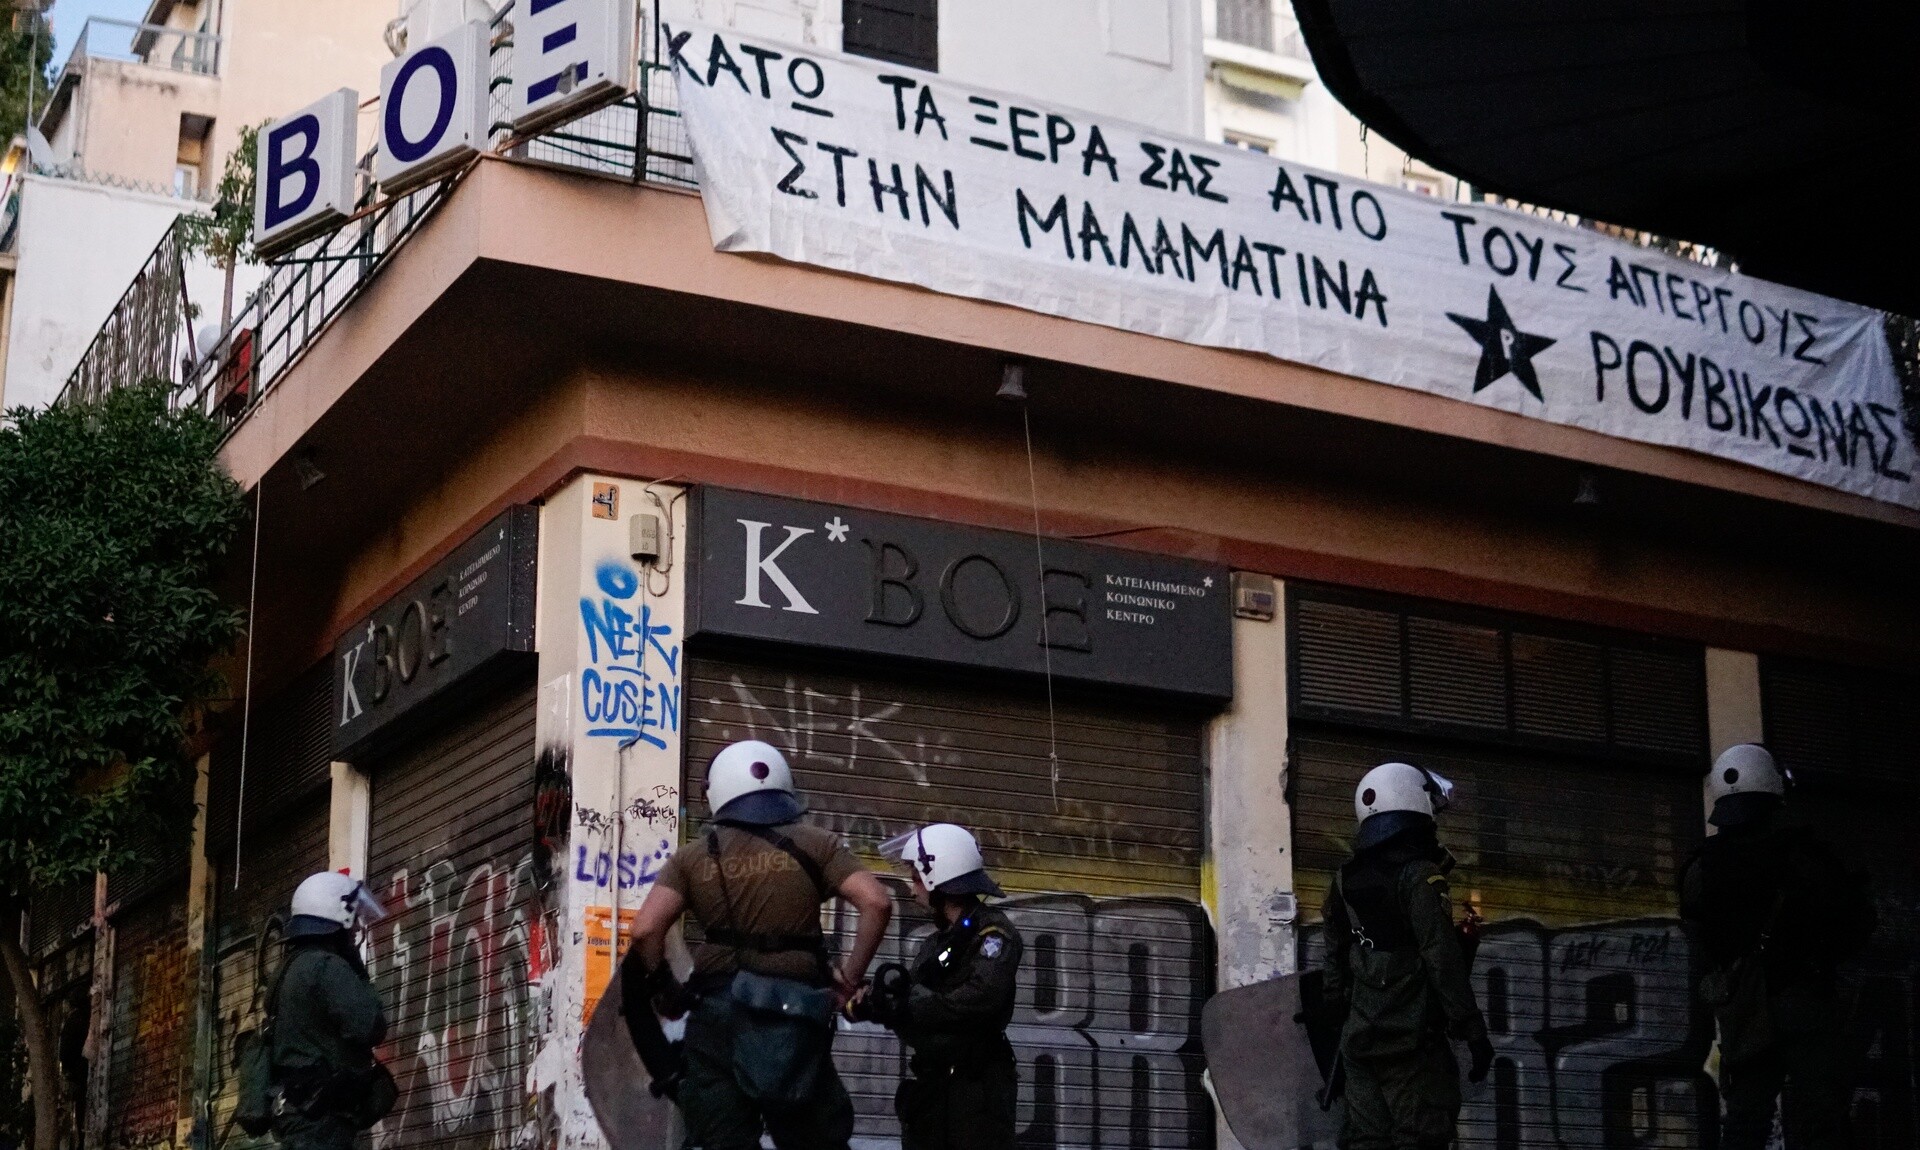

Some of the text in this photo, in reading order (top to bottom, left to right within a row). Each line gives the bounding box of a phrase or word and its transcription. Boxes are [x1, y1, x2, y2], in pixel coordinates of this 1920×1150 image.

[661, 22, 1828, 367] ΚΑΤΩ ΤΑ ΞΕΡΑ ΣΑΣ ΑΠΟ ΤΟΥΣ ΑΠΕΡΓΟΥΣ
[770, 126, 961, 231] ΣΤΗΝ
[1015, 188, 1389, 328] ΜΑΛΑΜΑΤΙΝΑ
[1589, 330, 1911, 483] ΡΟΥΒΙΚΩΝΑΣ
[1105, 573, 1206, 599] ΚΑΤΕΙΛΗΜΜΕΝΟ
[1106, 591, 1176, 611] ΚΟΙΝΩΝΙΚΟ
[1106, 609, 1155, 625] ΚΕΝΤΡΟ
